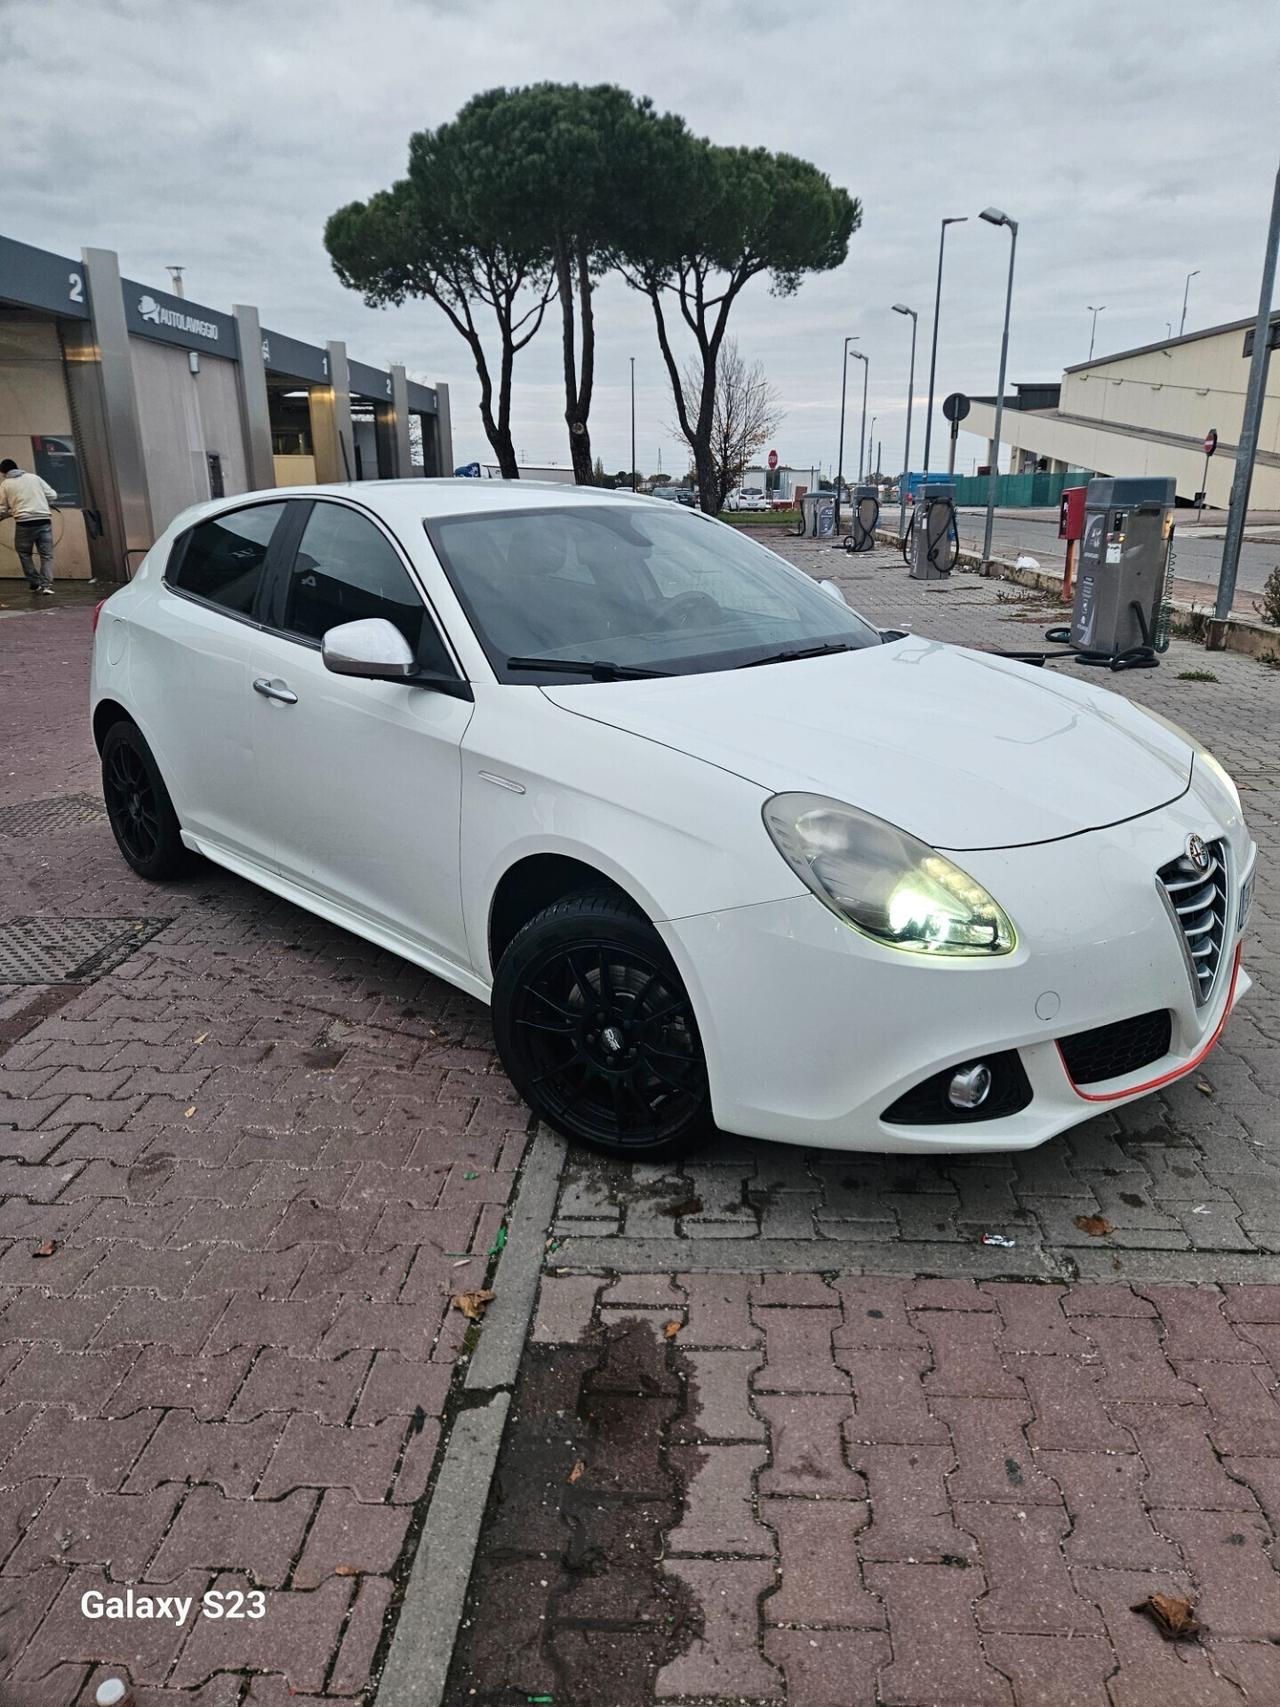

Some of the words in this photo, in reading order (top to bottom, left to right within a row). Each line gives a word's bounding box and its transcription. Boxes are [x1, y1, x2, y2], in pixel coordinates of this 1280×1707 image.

[69, 273, 83, 303] 2
[160, 308, 218, 340] AUTOLAVAGGIO
[322, 357, 328, 375] 1
[386, 379, 392, 395] 2
